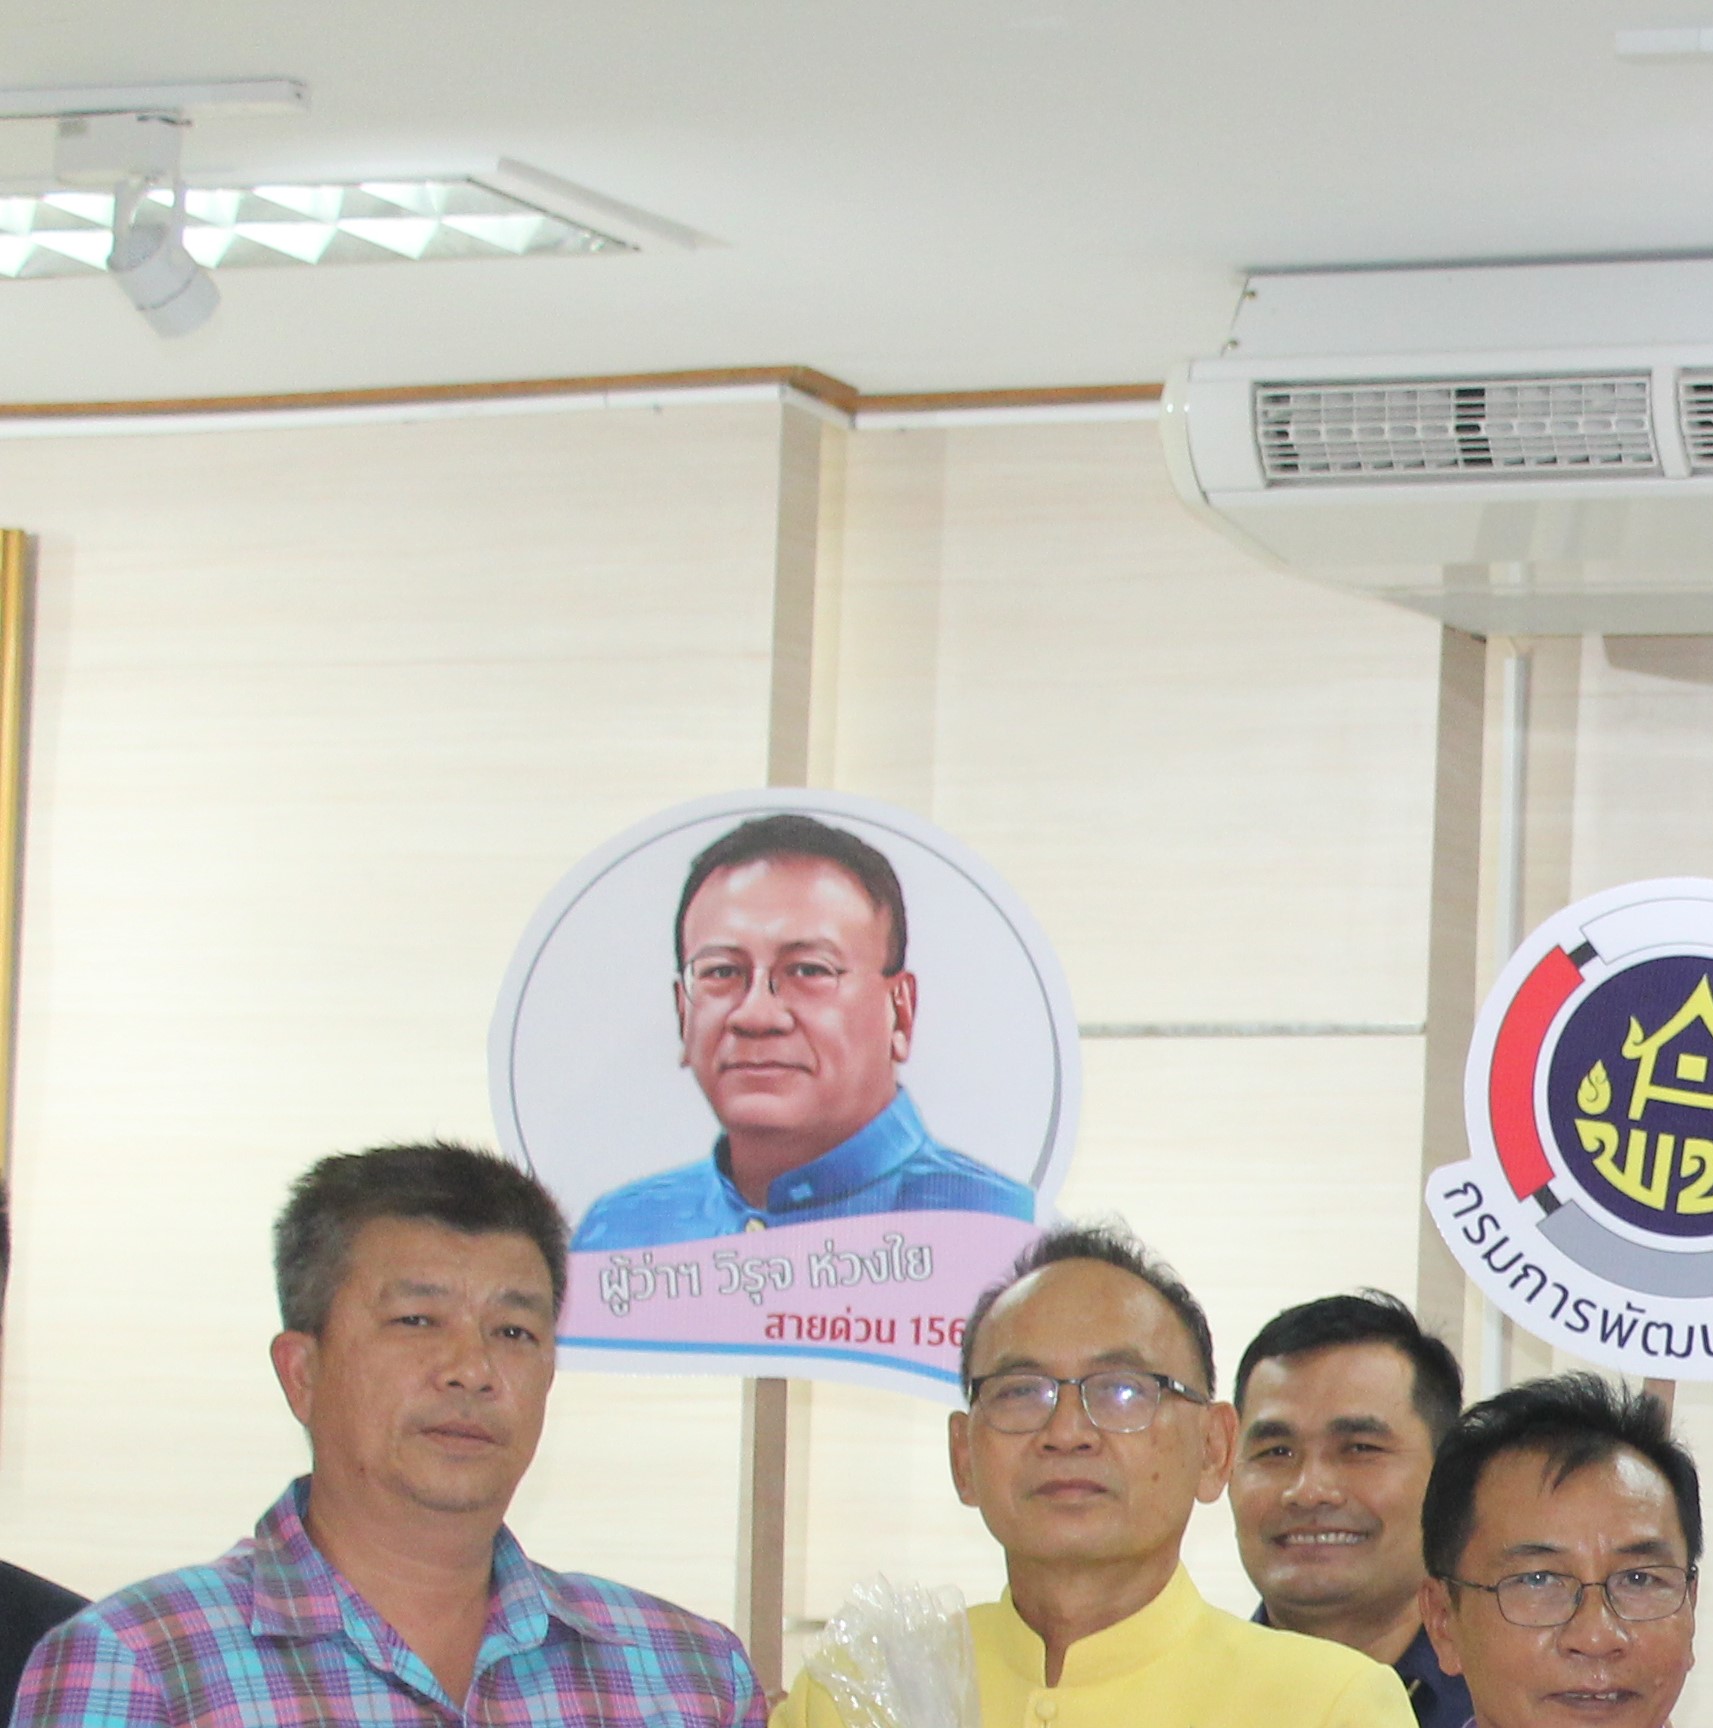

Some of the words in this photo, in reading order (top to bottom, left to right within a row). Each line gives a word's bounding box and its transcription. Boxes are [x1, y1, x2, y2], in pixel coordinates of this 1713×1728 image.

[599, 1253, 704, 1319] ผู้ว่าฯ
[714, 1248, 794, 1308] วิรุจ
[808, 1234, 936, 1290] ห่วงใย
[763, 1307, 897, 1346] สายด่วน
